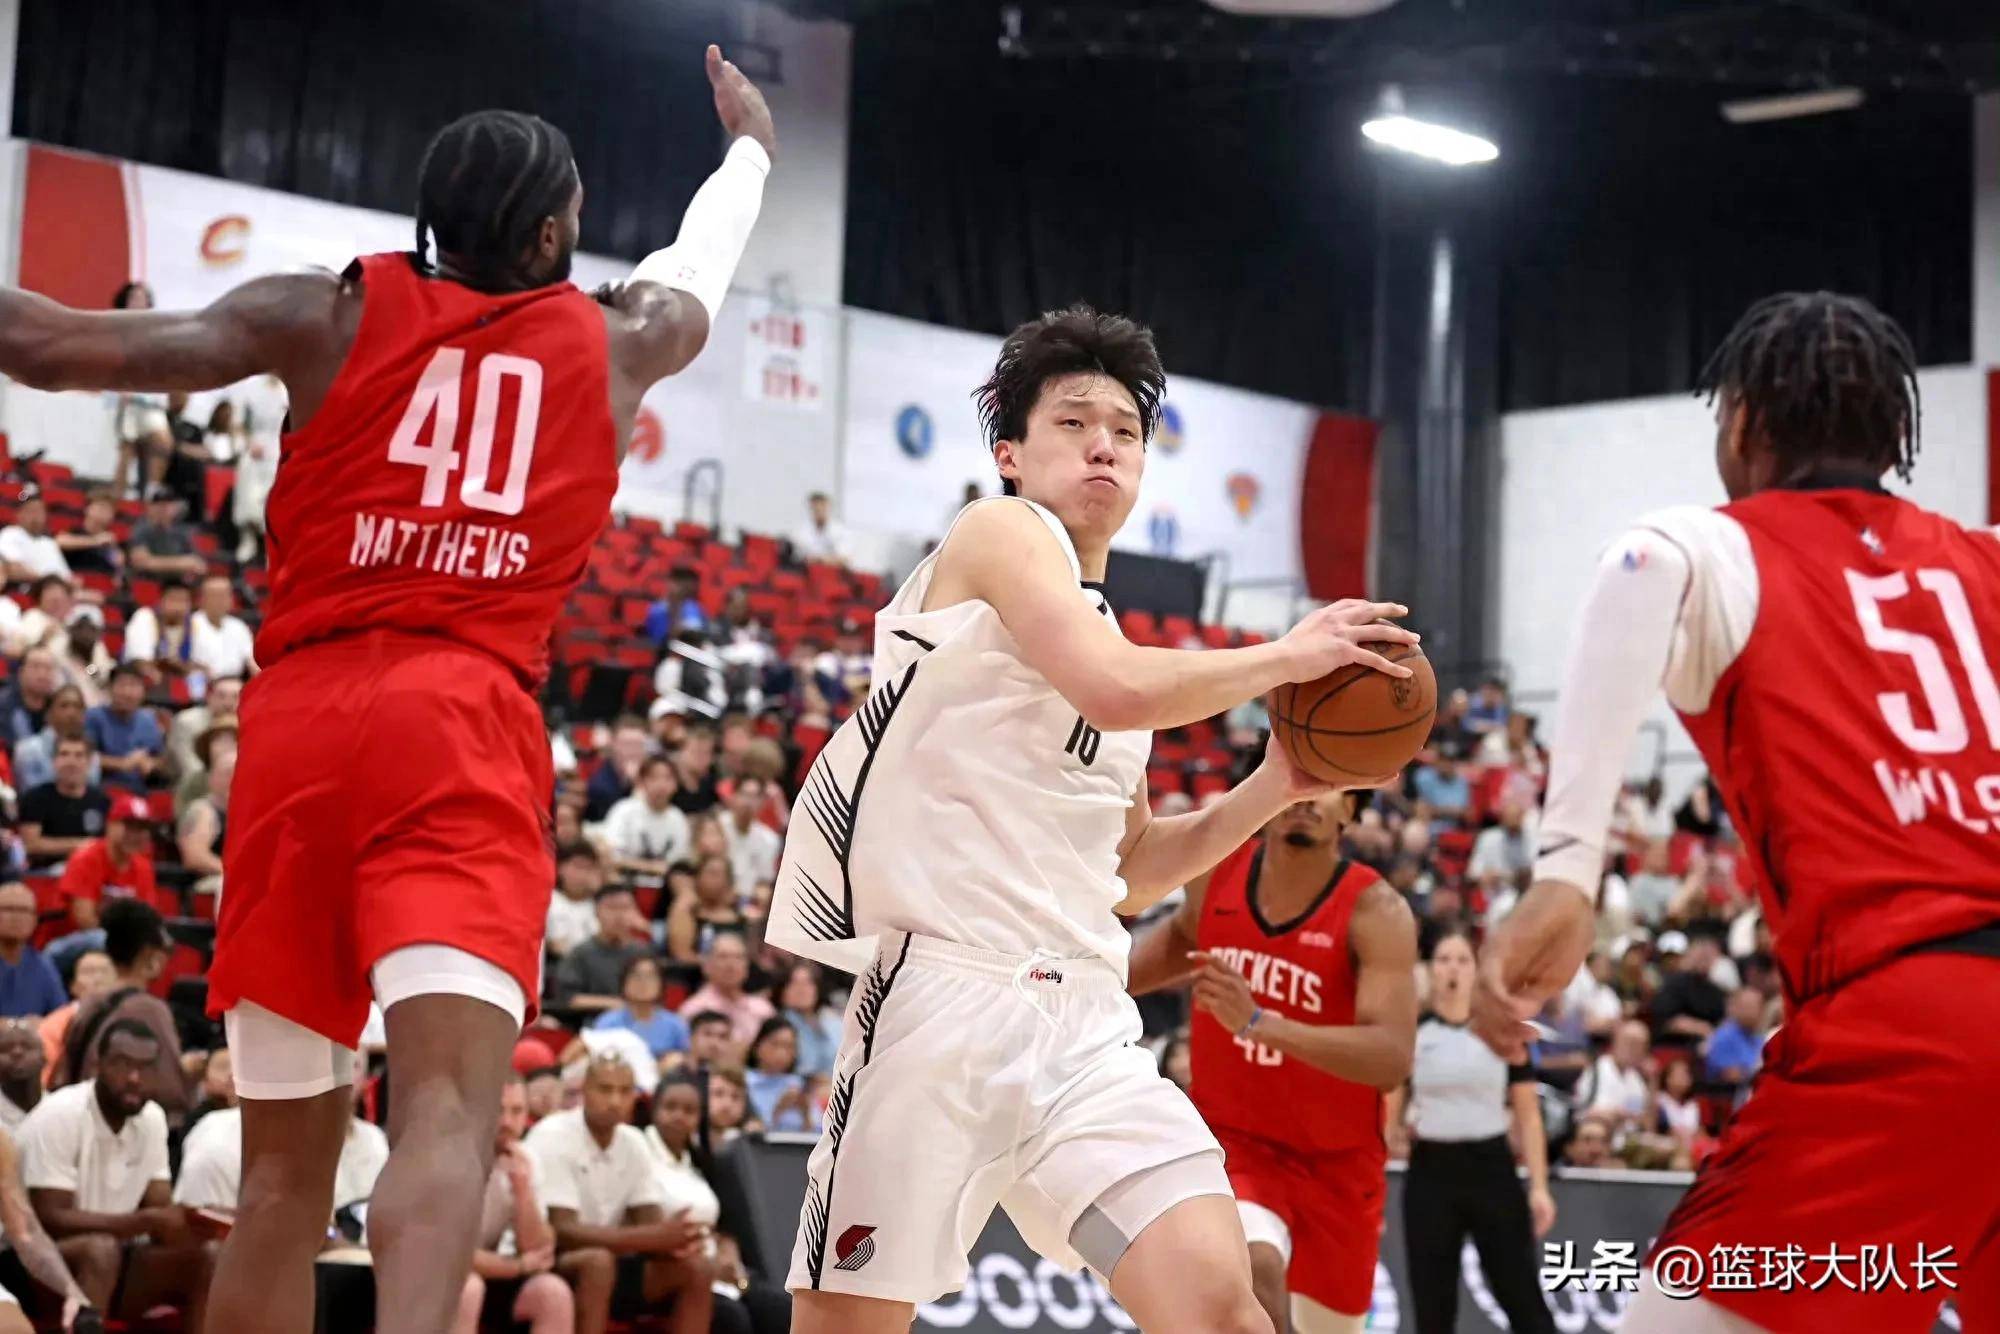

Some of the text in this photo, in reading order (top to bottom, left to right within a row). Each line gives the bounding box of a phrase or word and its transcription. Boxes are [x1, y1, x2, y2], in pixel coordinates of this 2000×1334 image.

[387, 346, 544, 516] 40
[349, 511, 530, 579] MATTHEWS
[1844, 567, 2000, 753] 51
[1210, 946, 1323, 1014] CKETS
